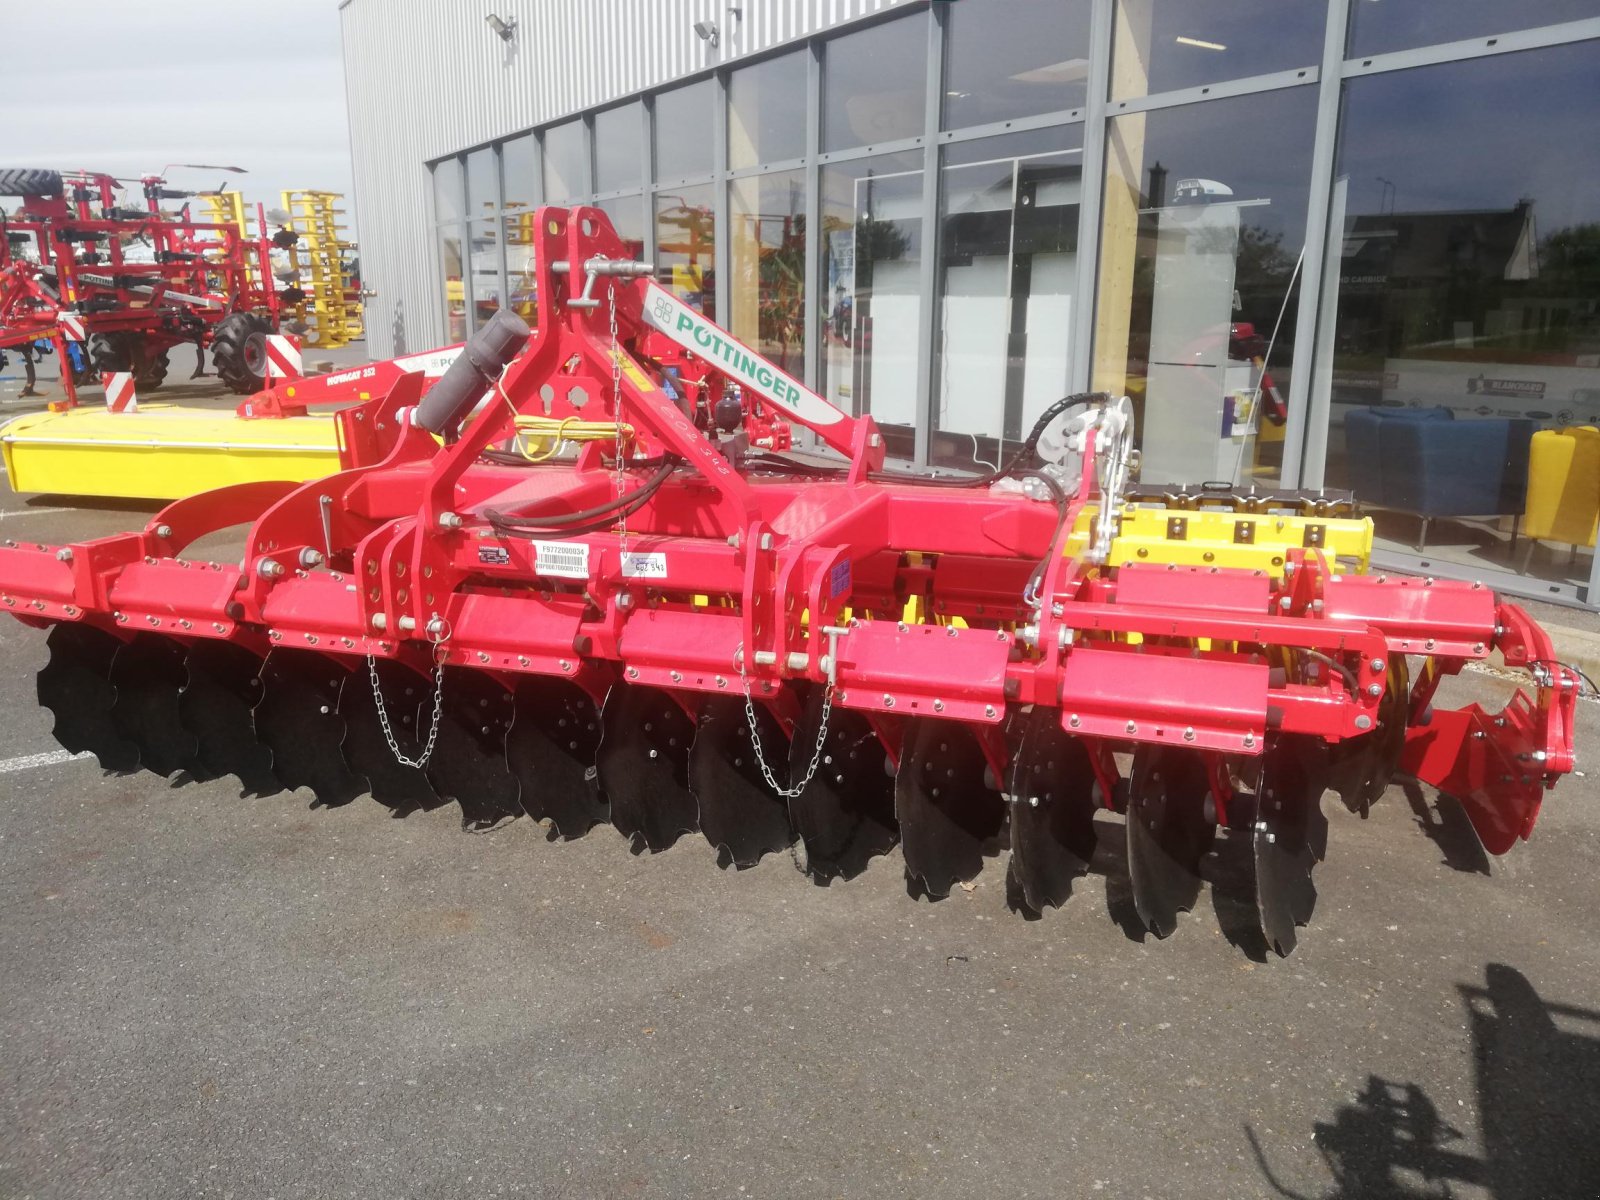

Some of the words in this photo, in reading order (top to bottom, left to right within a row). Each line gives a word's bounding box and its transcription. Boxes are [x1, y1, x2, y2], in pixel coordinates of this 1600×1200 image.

[326, 370, 361, 387] NOVACAT
[363, 367, 376, 378] 352
[676, 311, 801, 408] PÖTTINGER
